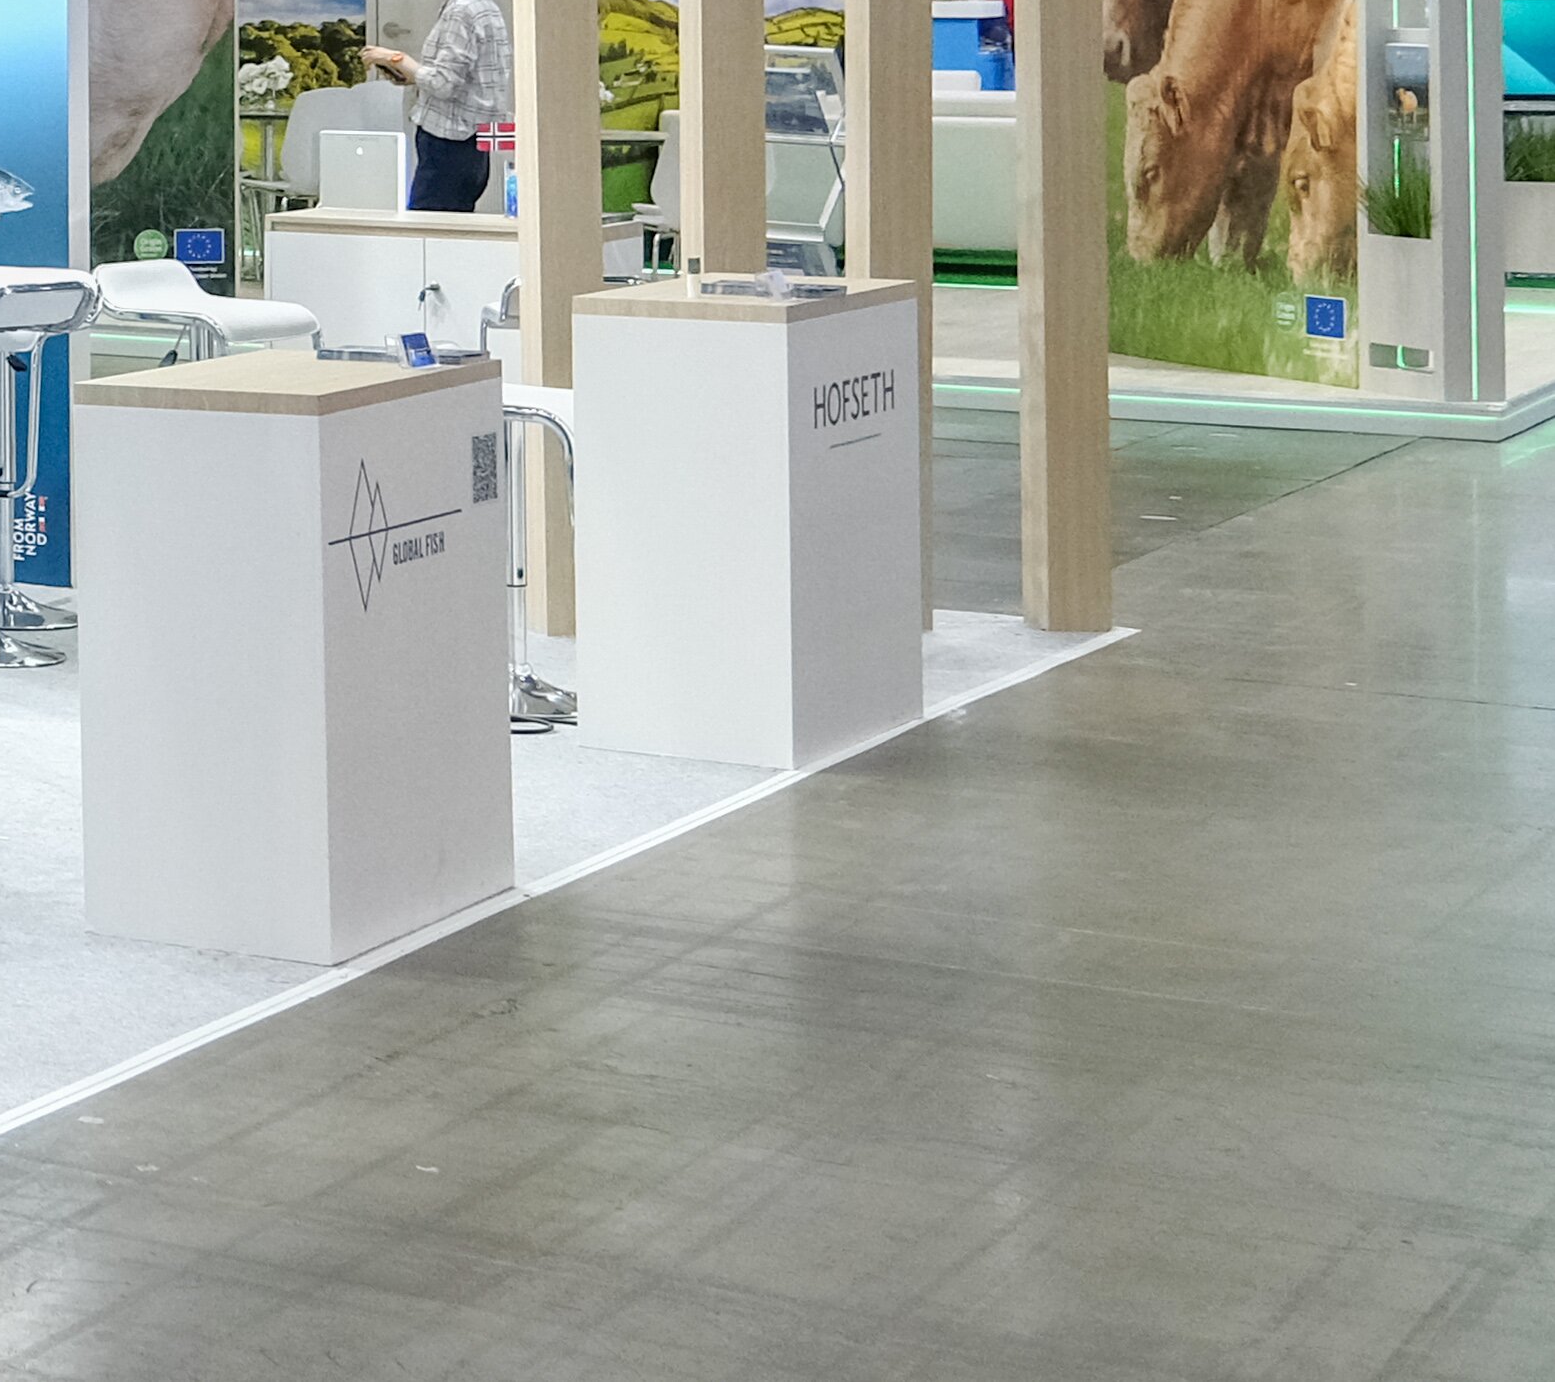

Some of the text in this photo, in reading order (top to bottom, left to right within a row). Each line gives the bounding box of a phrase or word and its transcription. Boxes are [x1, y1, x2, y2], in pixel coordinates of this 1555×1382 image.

[812, 369, 896, 431] HOFSETH
[392, 530, 446, 566] GLOBAL FISH
